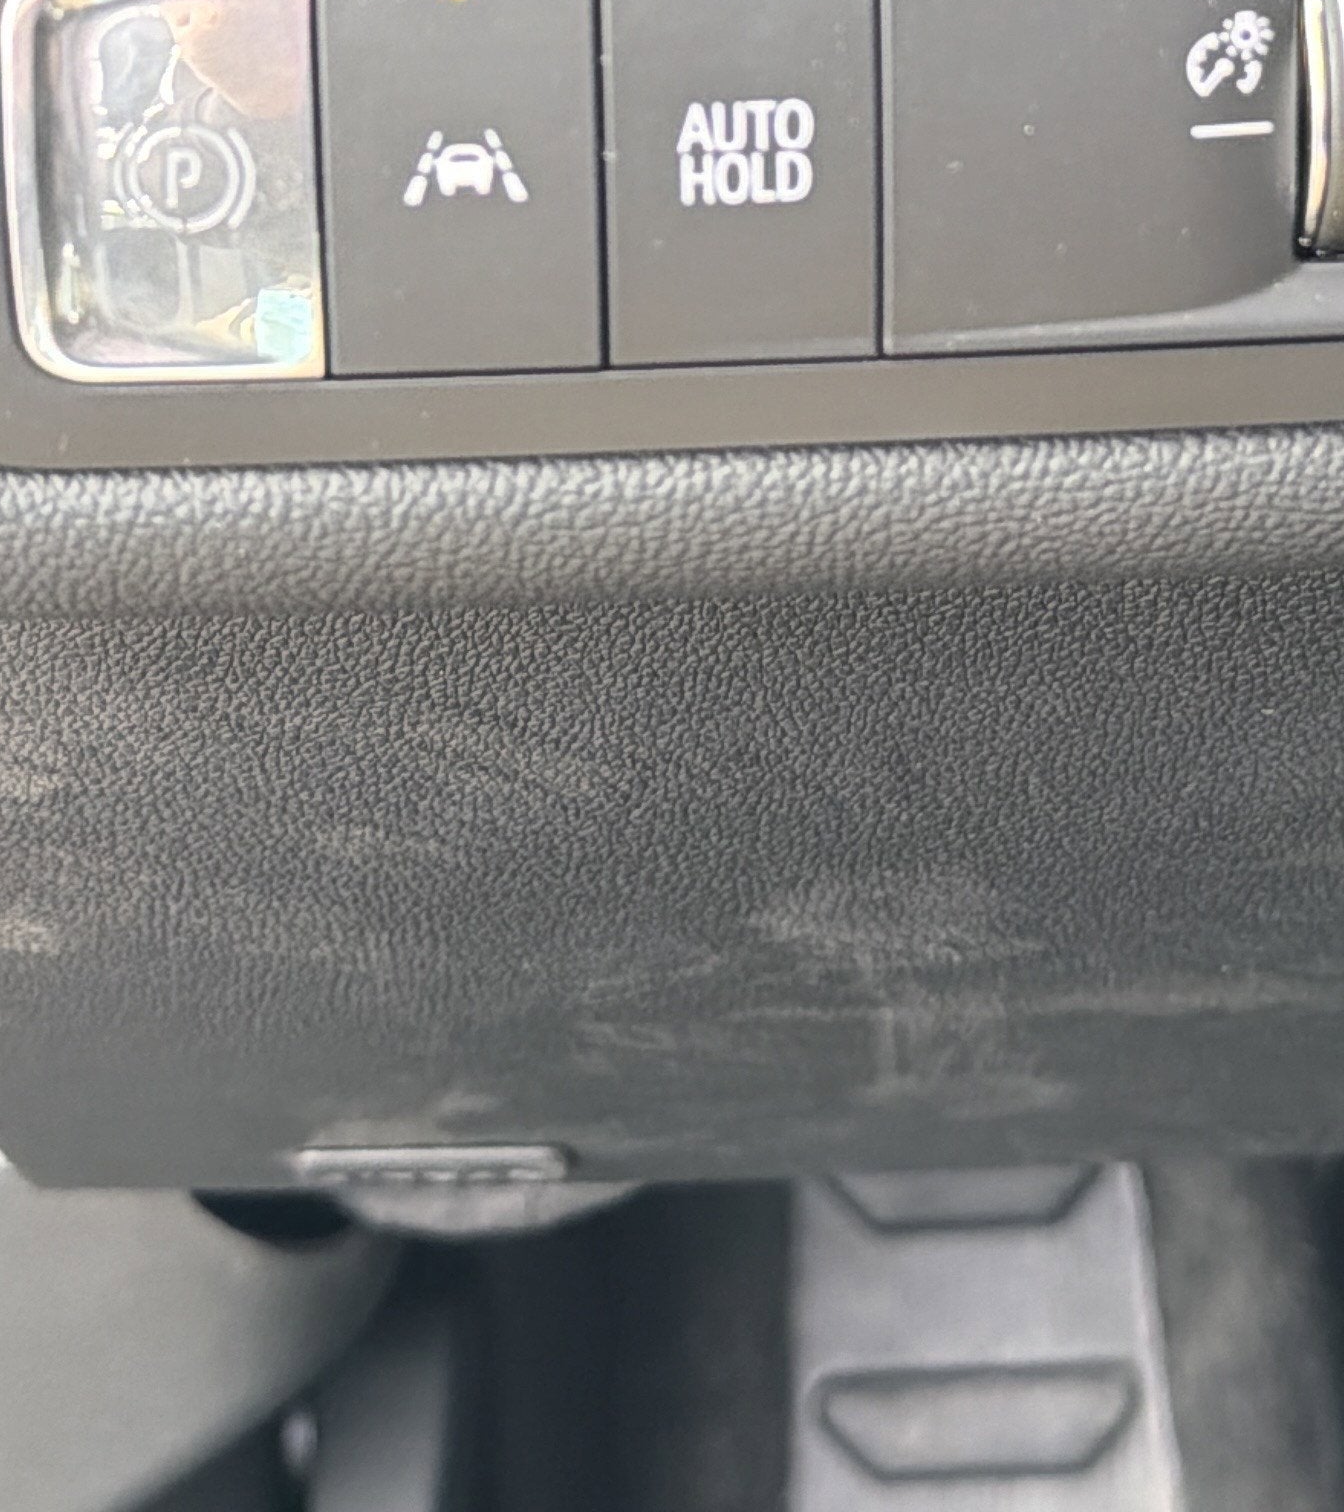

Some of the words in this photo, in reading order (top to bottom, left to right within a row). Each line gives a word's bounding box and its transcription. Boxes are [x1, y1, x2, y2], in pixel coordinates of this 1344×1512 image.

[676, 97, 815, 153] AUTO
[166, 148, 203, 209] P
[679, 150, 814, 207] HOLD
